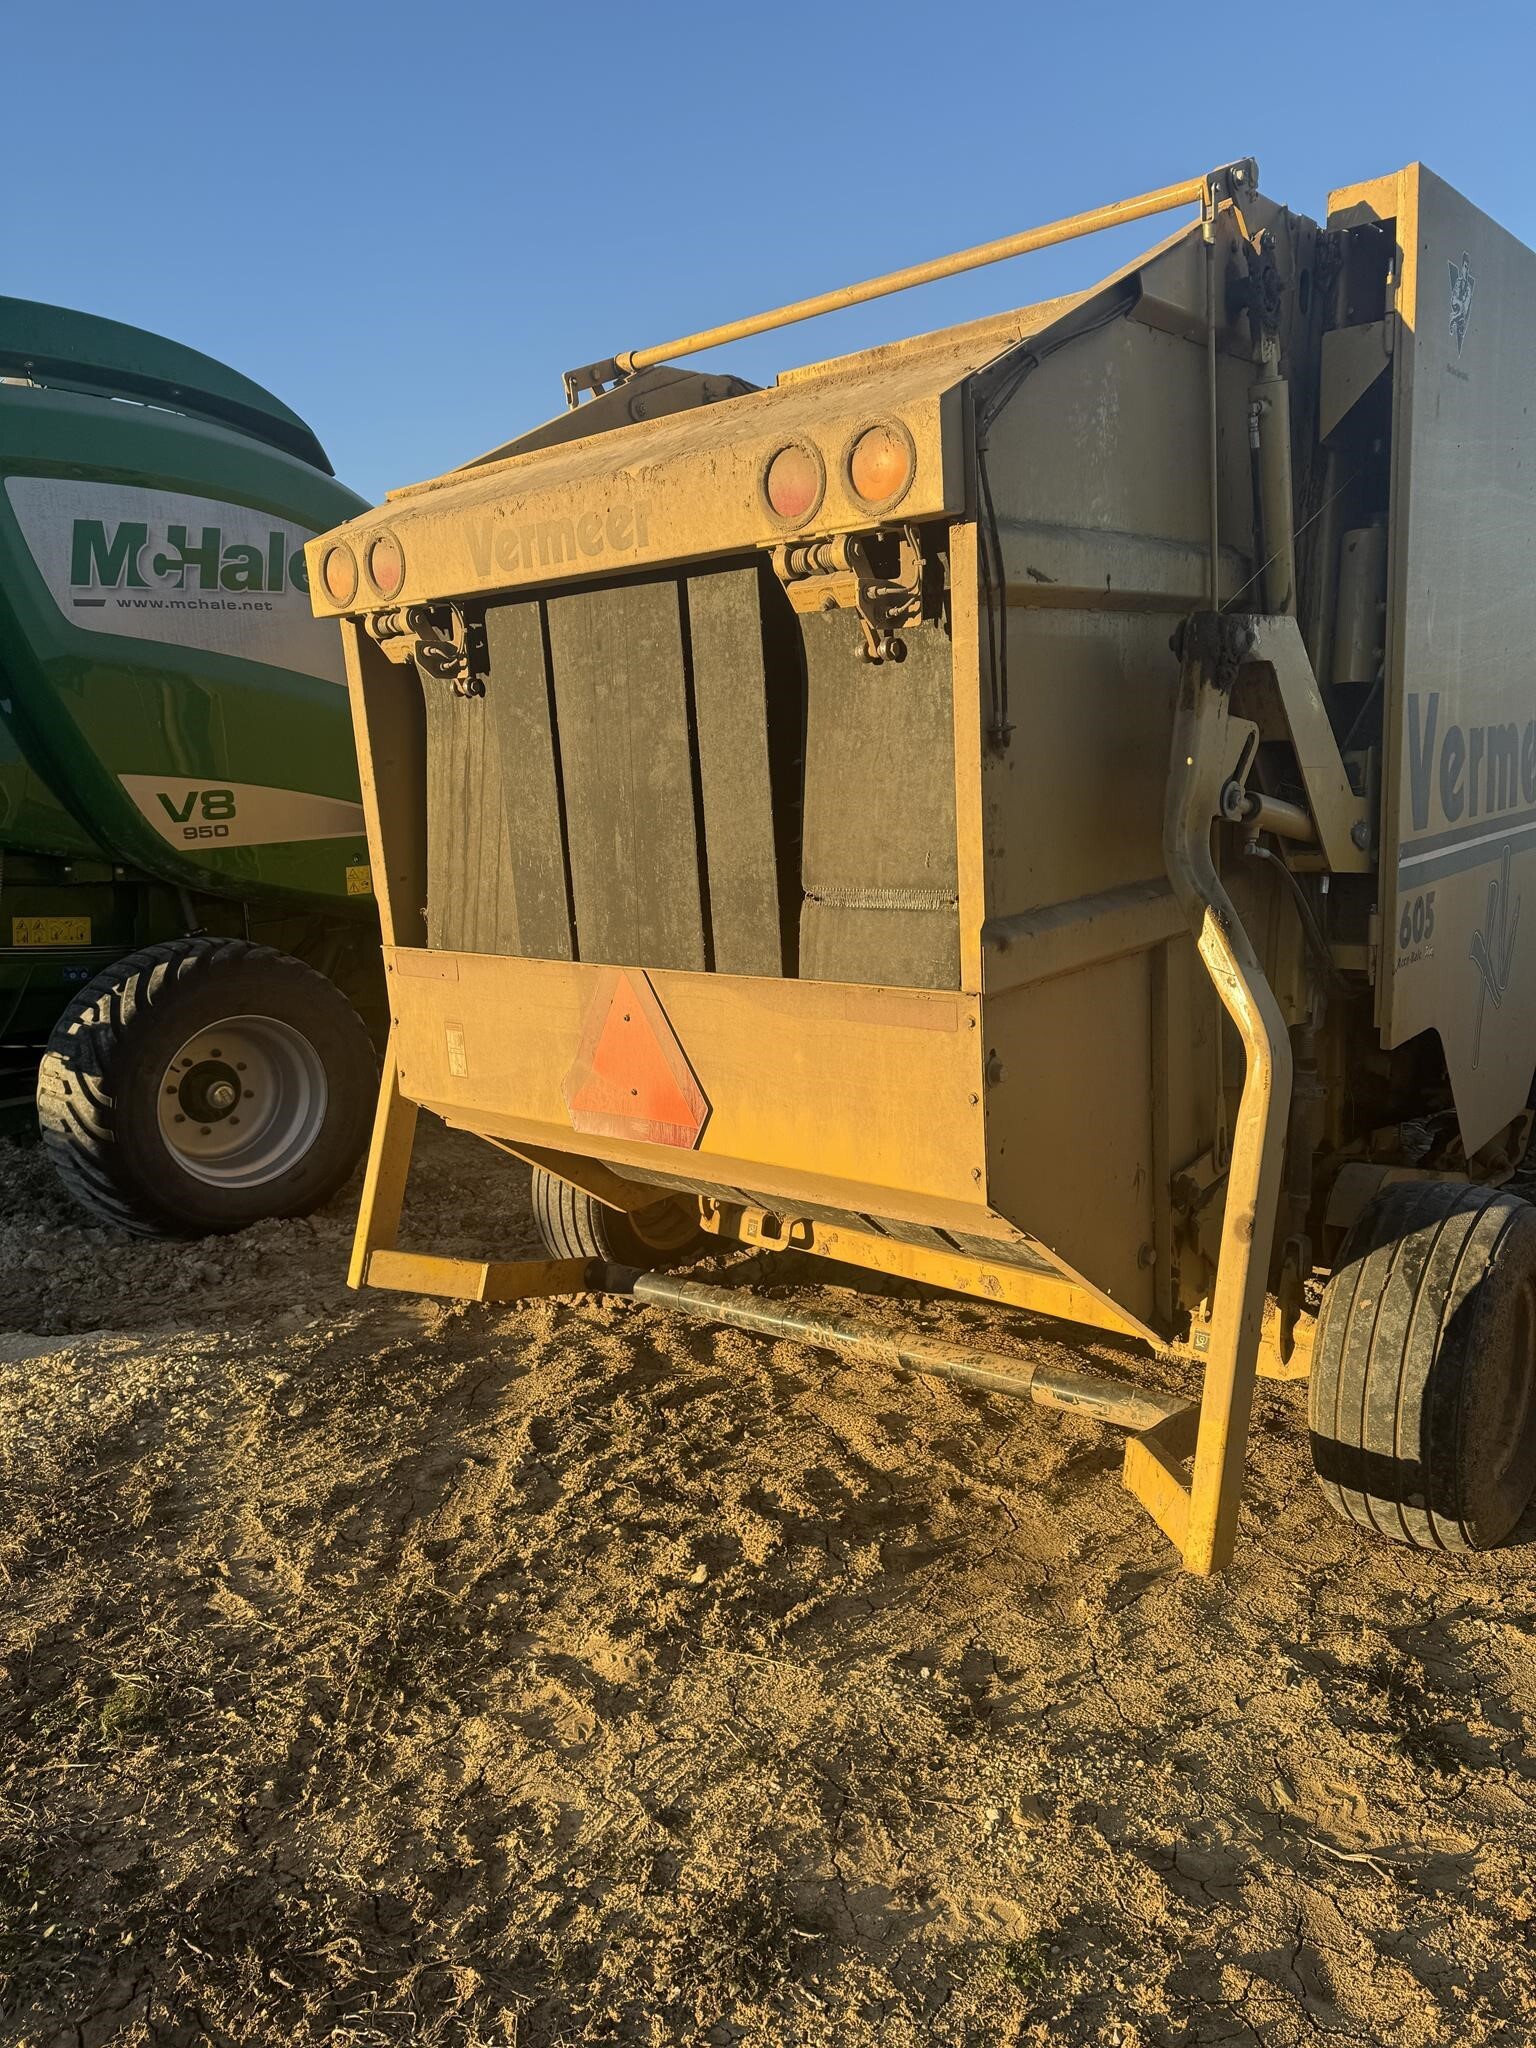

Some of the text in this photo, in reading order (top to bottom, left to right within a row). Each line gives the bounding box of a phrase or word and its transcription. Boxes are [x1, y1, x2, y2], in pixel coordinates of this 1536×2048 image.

[463, 498, 650, 577] Vermeer
[117, 598, 273, 611] www.mchale.net
[156, 789, 237, 823] V8
[183, 824, 229, 840] 950
[1399, 891, 1436, 949] 605
